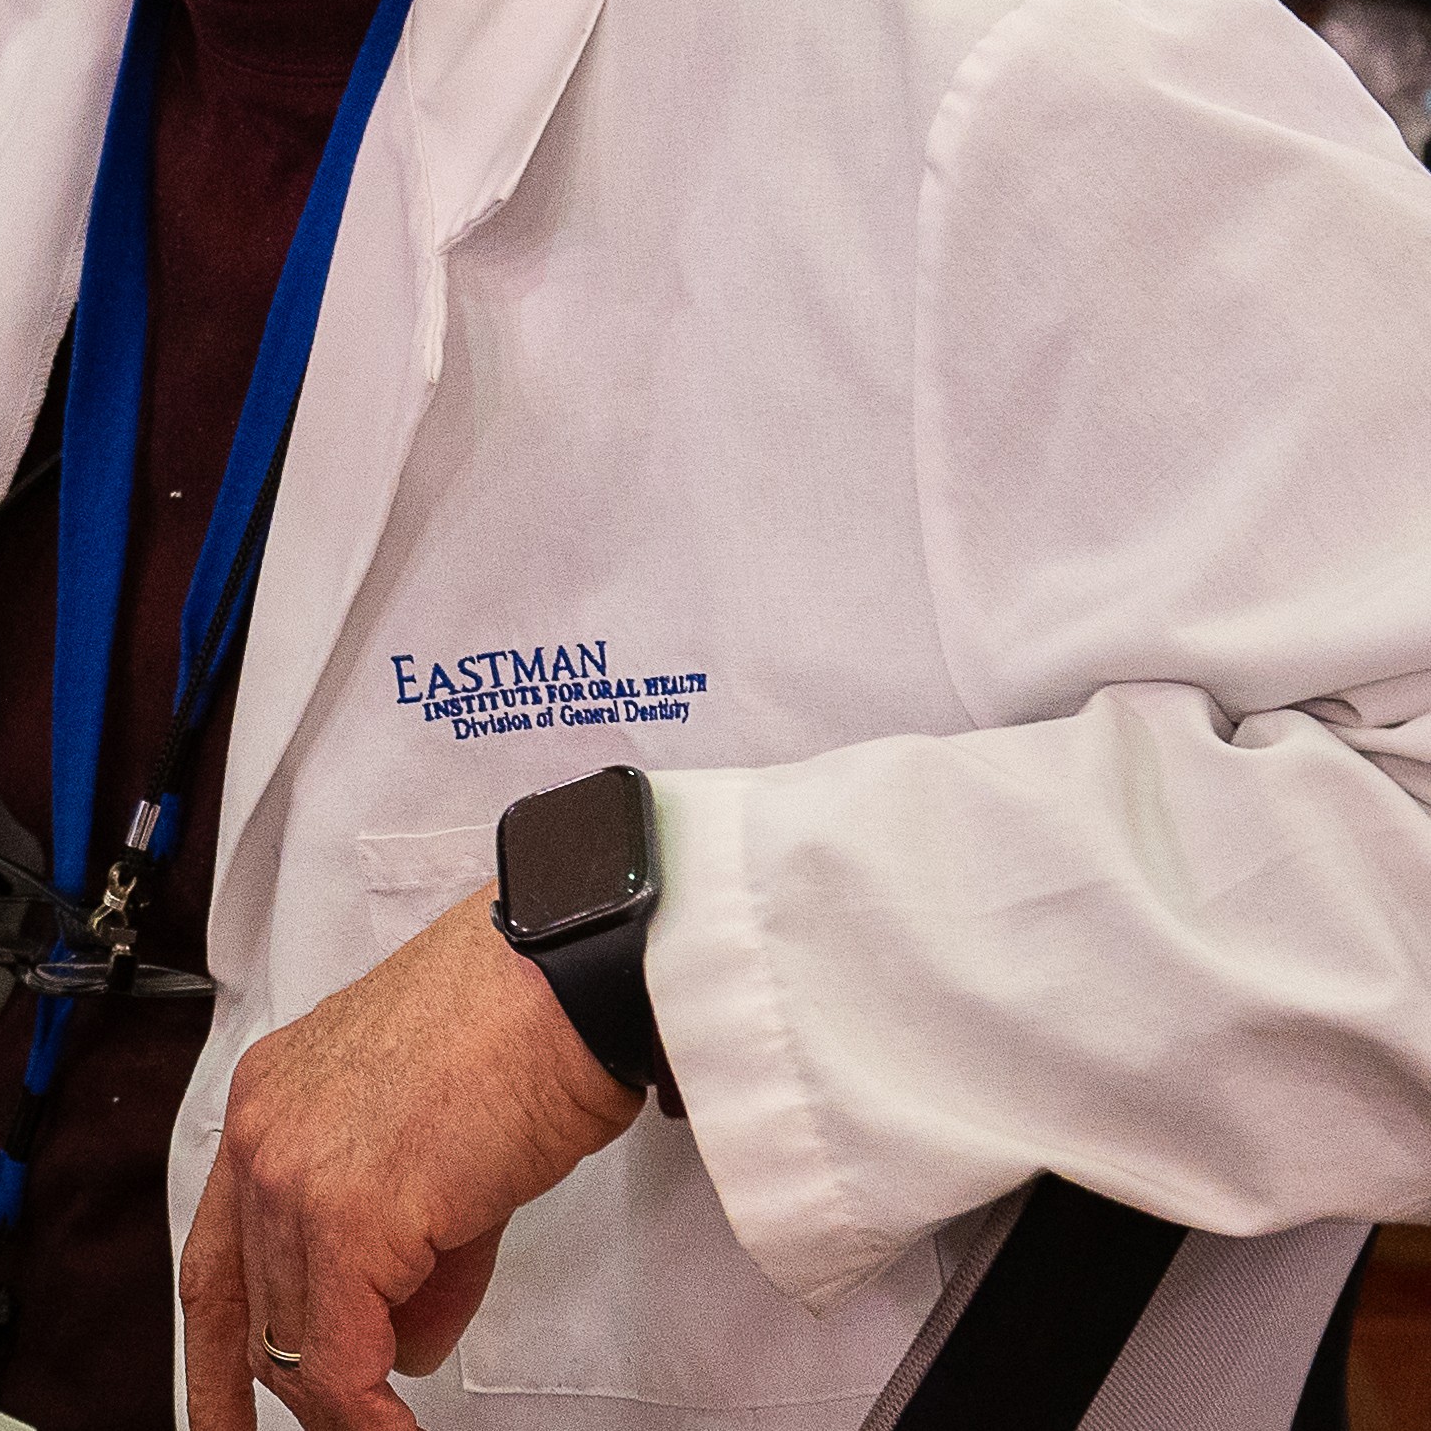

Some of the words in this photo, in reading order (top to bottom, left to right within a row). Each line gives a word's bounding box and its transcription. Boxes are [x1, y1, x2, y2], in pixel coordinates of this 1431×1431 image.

[390, 640, 607, 704] EASTMAN
[422, 686, 543, 722] INSTITUTE
[545, 682, 587, 704] FOR
[588, 678, 640, 701] ORAL
[643, 673, 707, 697] HEALTH
[451, 712, 532, 740] Division
[536, 706, 554, 728] of
[560, 700, 620, 727] General
[623, 697, 690, 724] Dentistry
